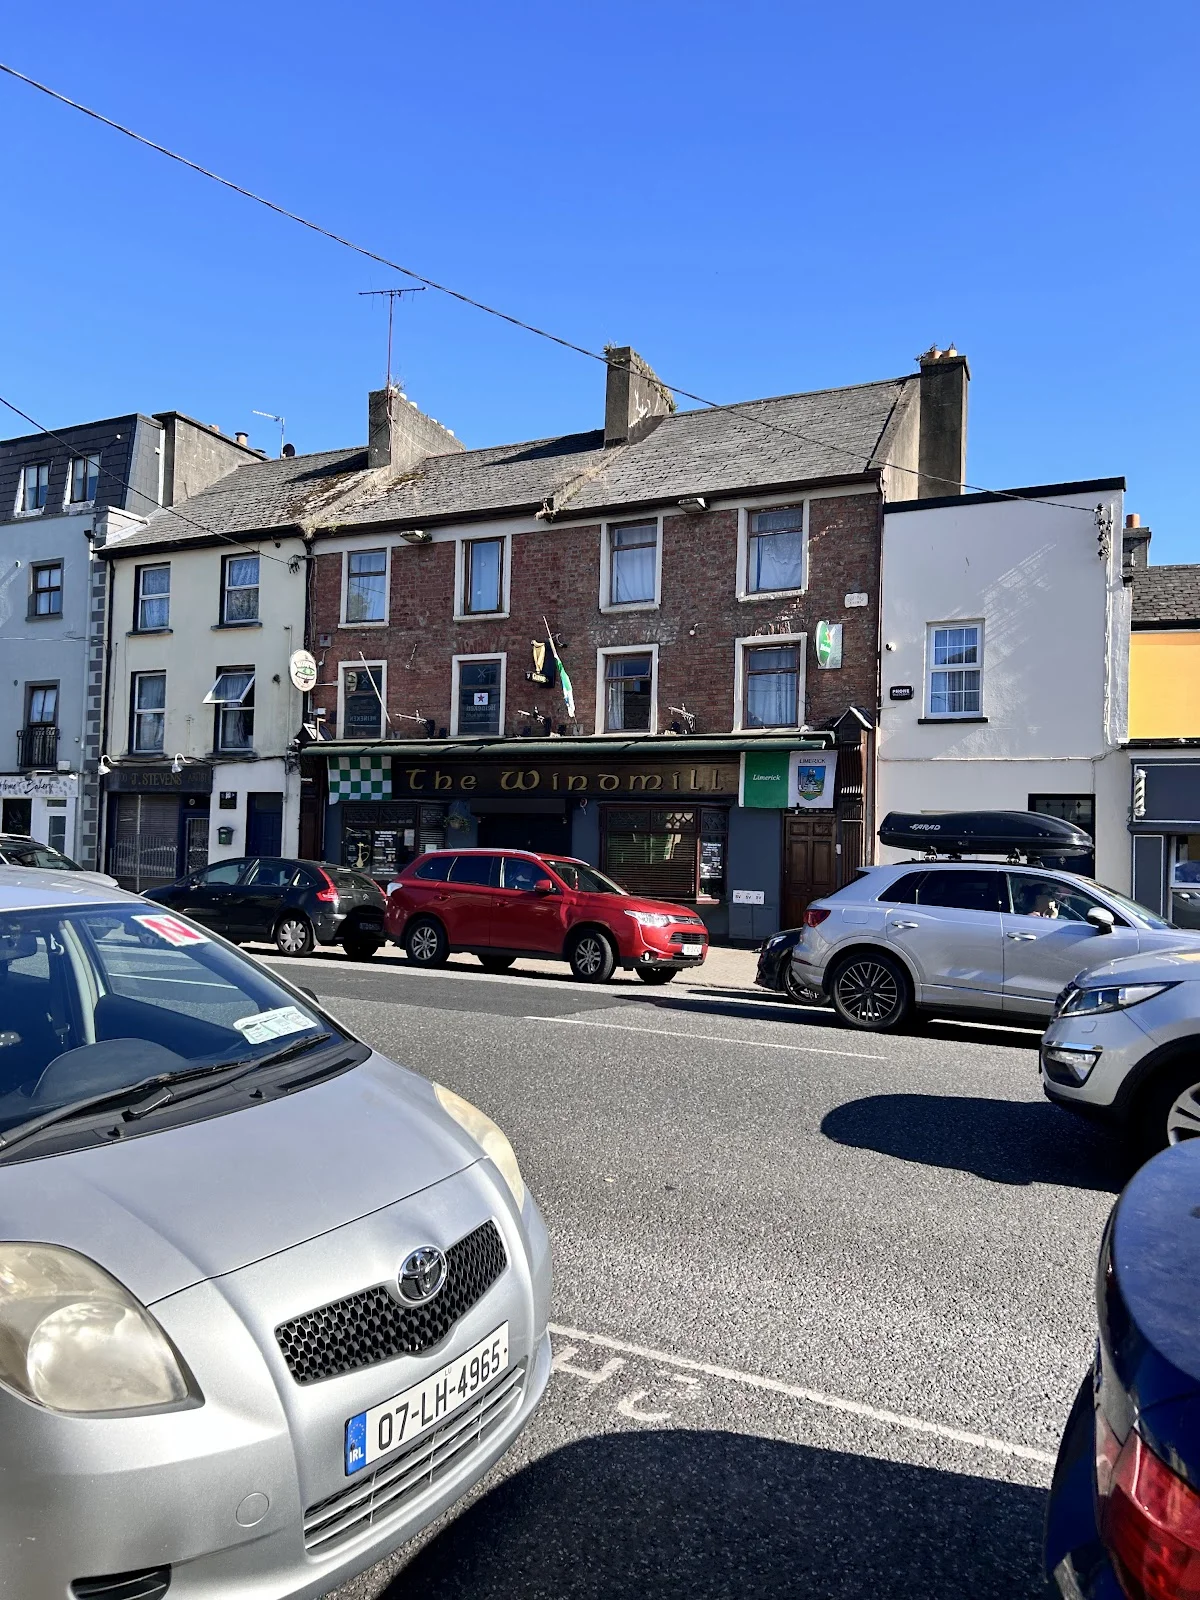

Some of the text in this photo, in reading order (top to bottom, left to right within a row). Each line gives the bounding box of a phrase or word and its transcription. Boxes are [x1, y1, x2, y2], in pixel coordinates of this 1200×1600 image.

[142, 772, 182, 786] STEVENS
[405, 768, 724, 791] The Windmill
[378, 1338, 501, 1451] 07-LH-4965
[349, 1446, 365, 1463] IRL
